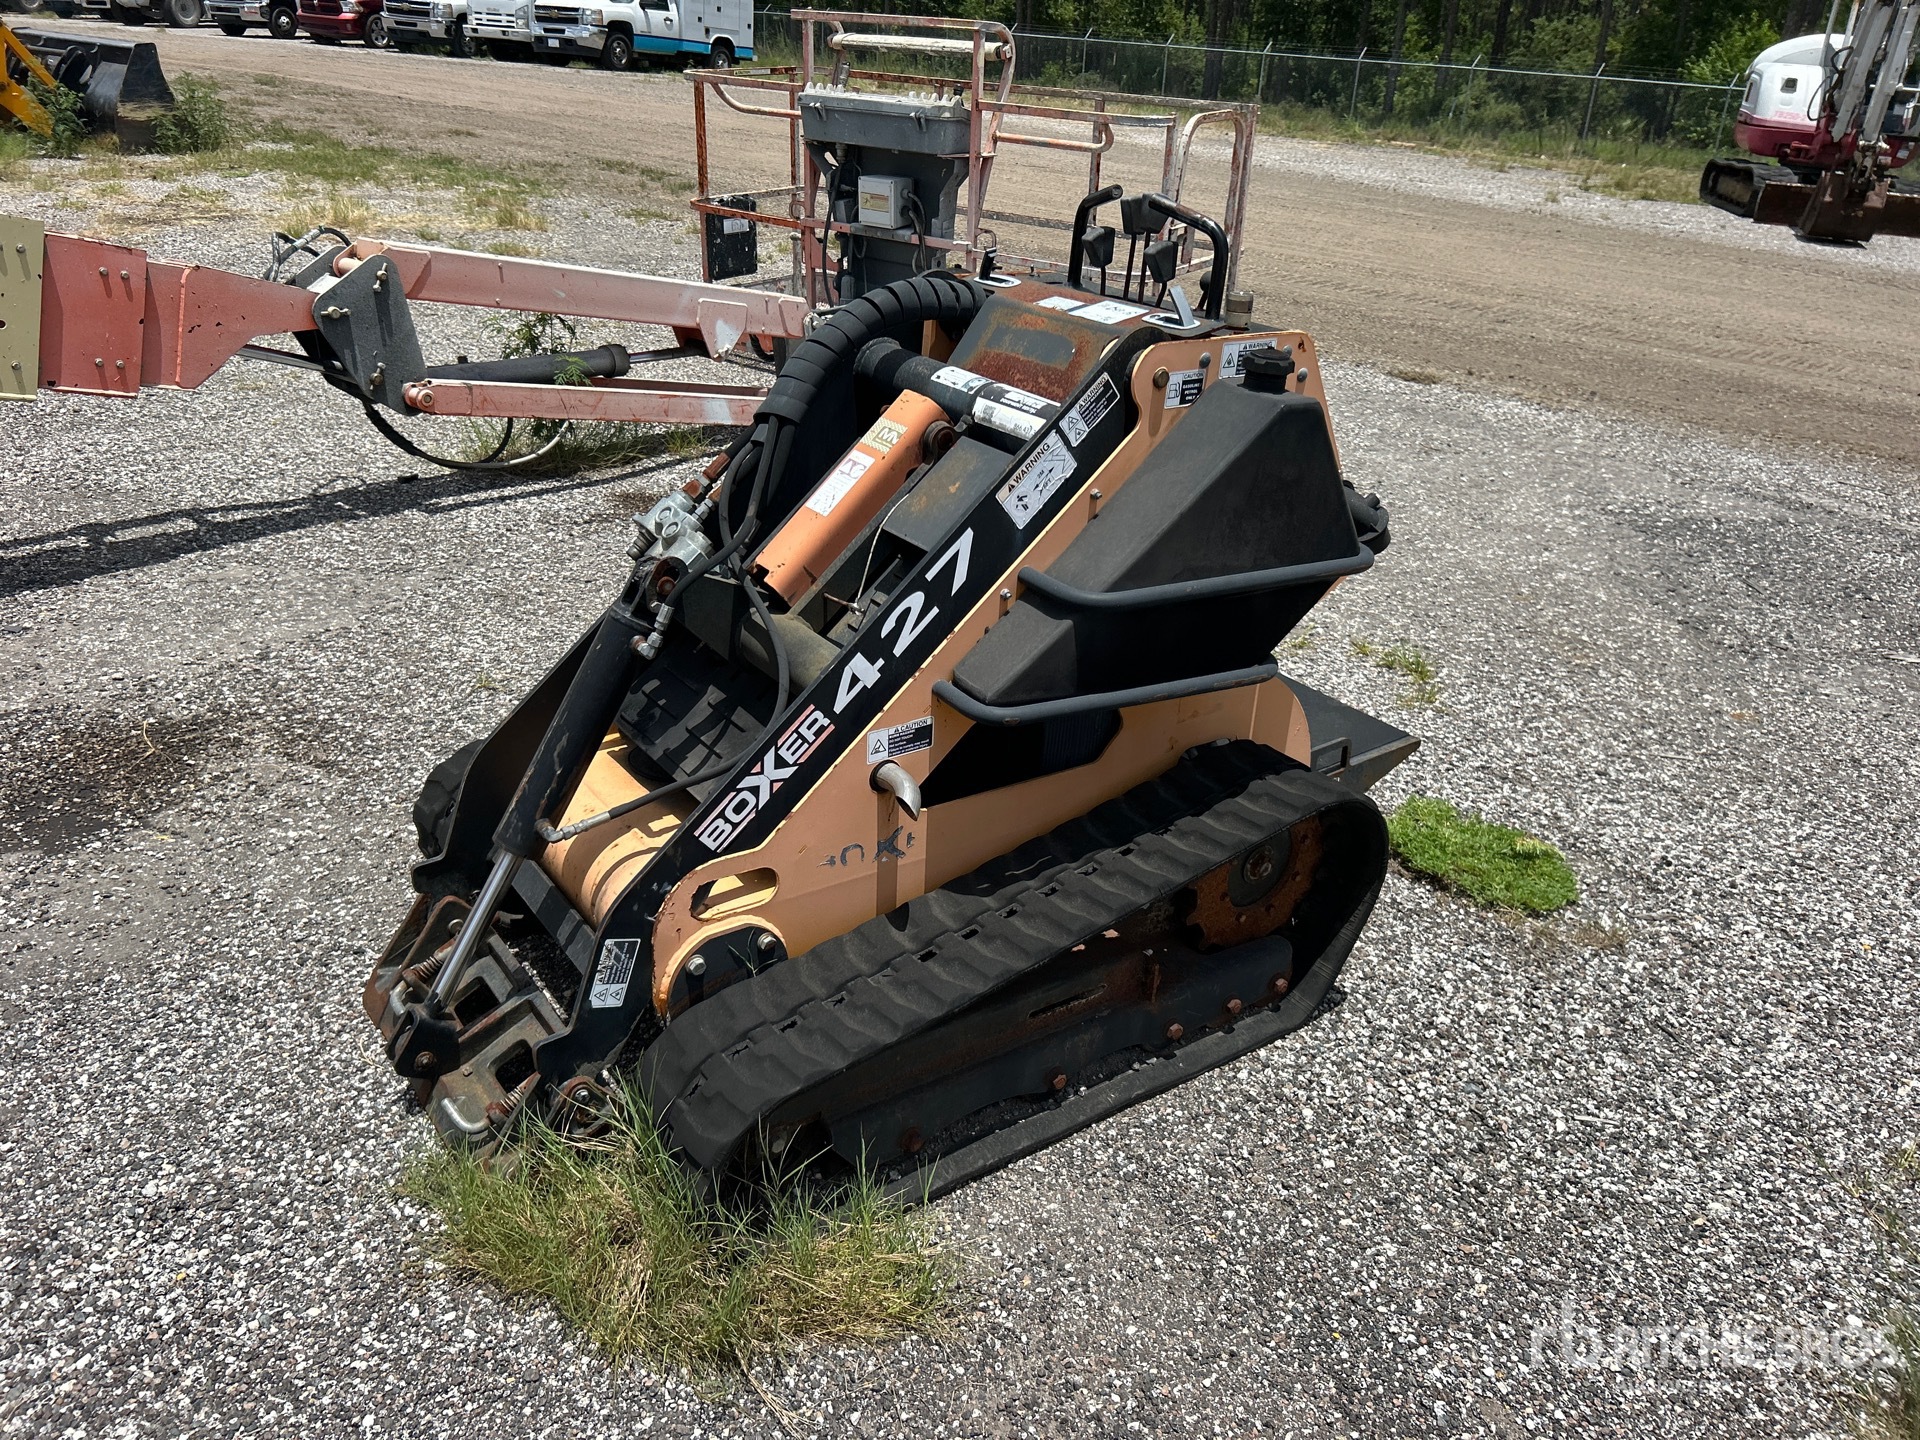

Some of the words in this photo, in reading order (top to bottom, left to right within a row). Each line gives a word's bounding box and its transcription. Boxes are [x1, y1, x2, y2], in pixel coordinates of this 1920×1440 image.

[1082, 377, 1107, 405] WARNING
[1013, 442, 1051, 484] WARNING
[698, 708, 832, 852] BOXER
[832, 526, 974, 715] 427
[900, 719, 928, 732] CAUTION
